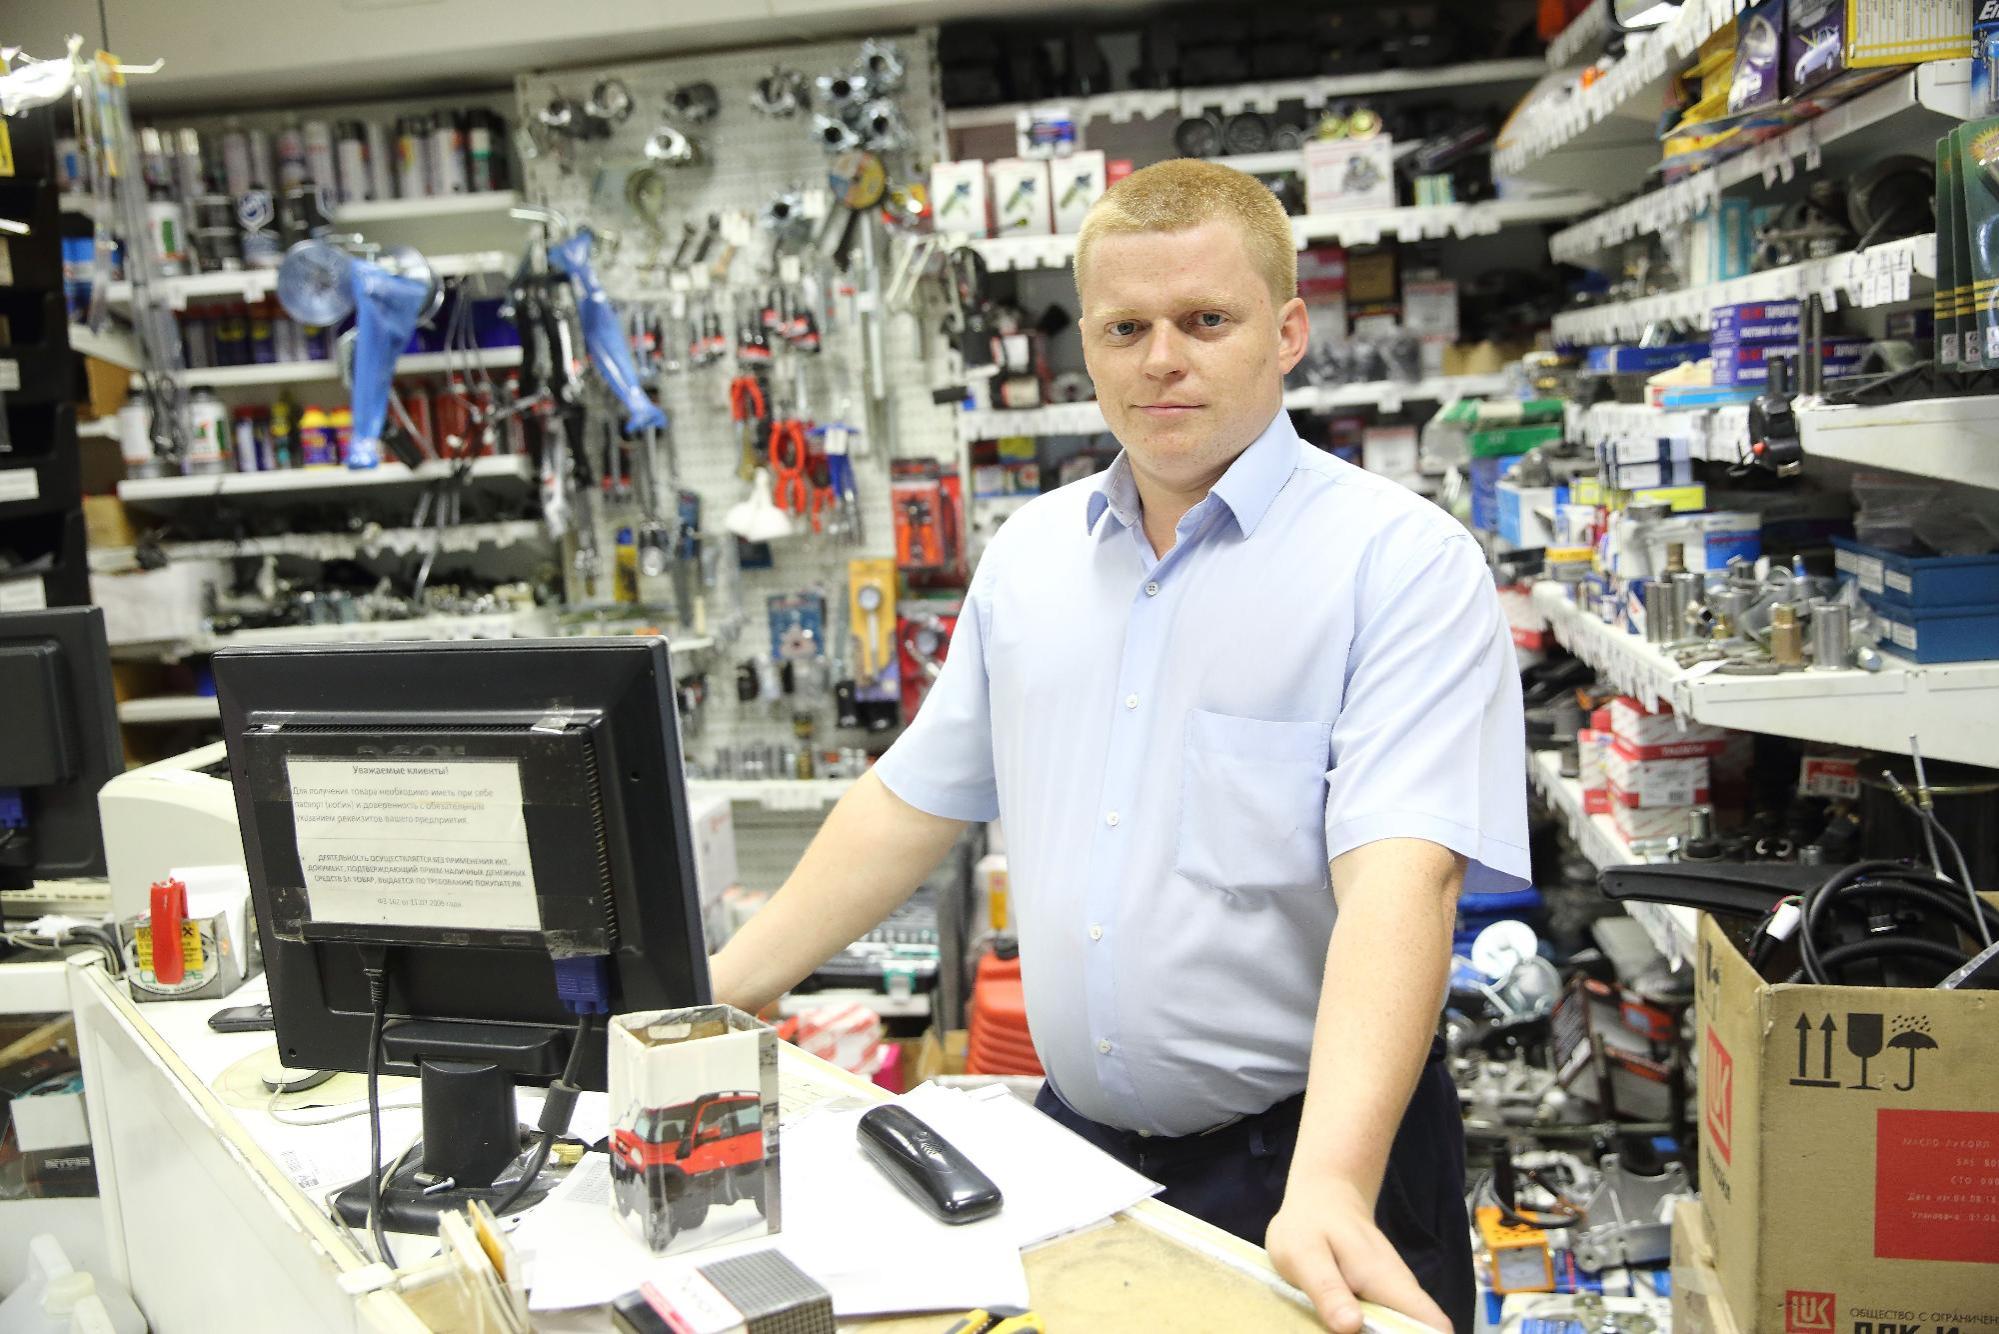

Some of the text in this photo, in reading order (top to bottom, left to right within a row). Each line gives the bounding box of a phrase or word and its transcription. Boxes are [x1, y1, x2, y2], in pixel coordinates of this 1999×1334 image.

[352, 765, 449, 775] Уважаемые клиенты!
[292, 786, 494, 798] Для получения товара необходимо иметь при себе
[363, 801, 418, 811] доверенность
[338, 815, 383, 824] реквизитов
[385, 816, 413, 824] вашего
[318, 854, 369, 862] ДЕЯТЕЛЬНОСТЬ
[347, 864, 418, 873] ПОДТВЕРЖДАЮЩИЙ
[444, 867, 483, 876] НАЛИЧНЫХ
[1850, 1307, 1915, 1321] ОБЩЕСТВО
[1919, 1311, 1929, 1322] С
